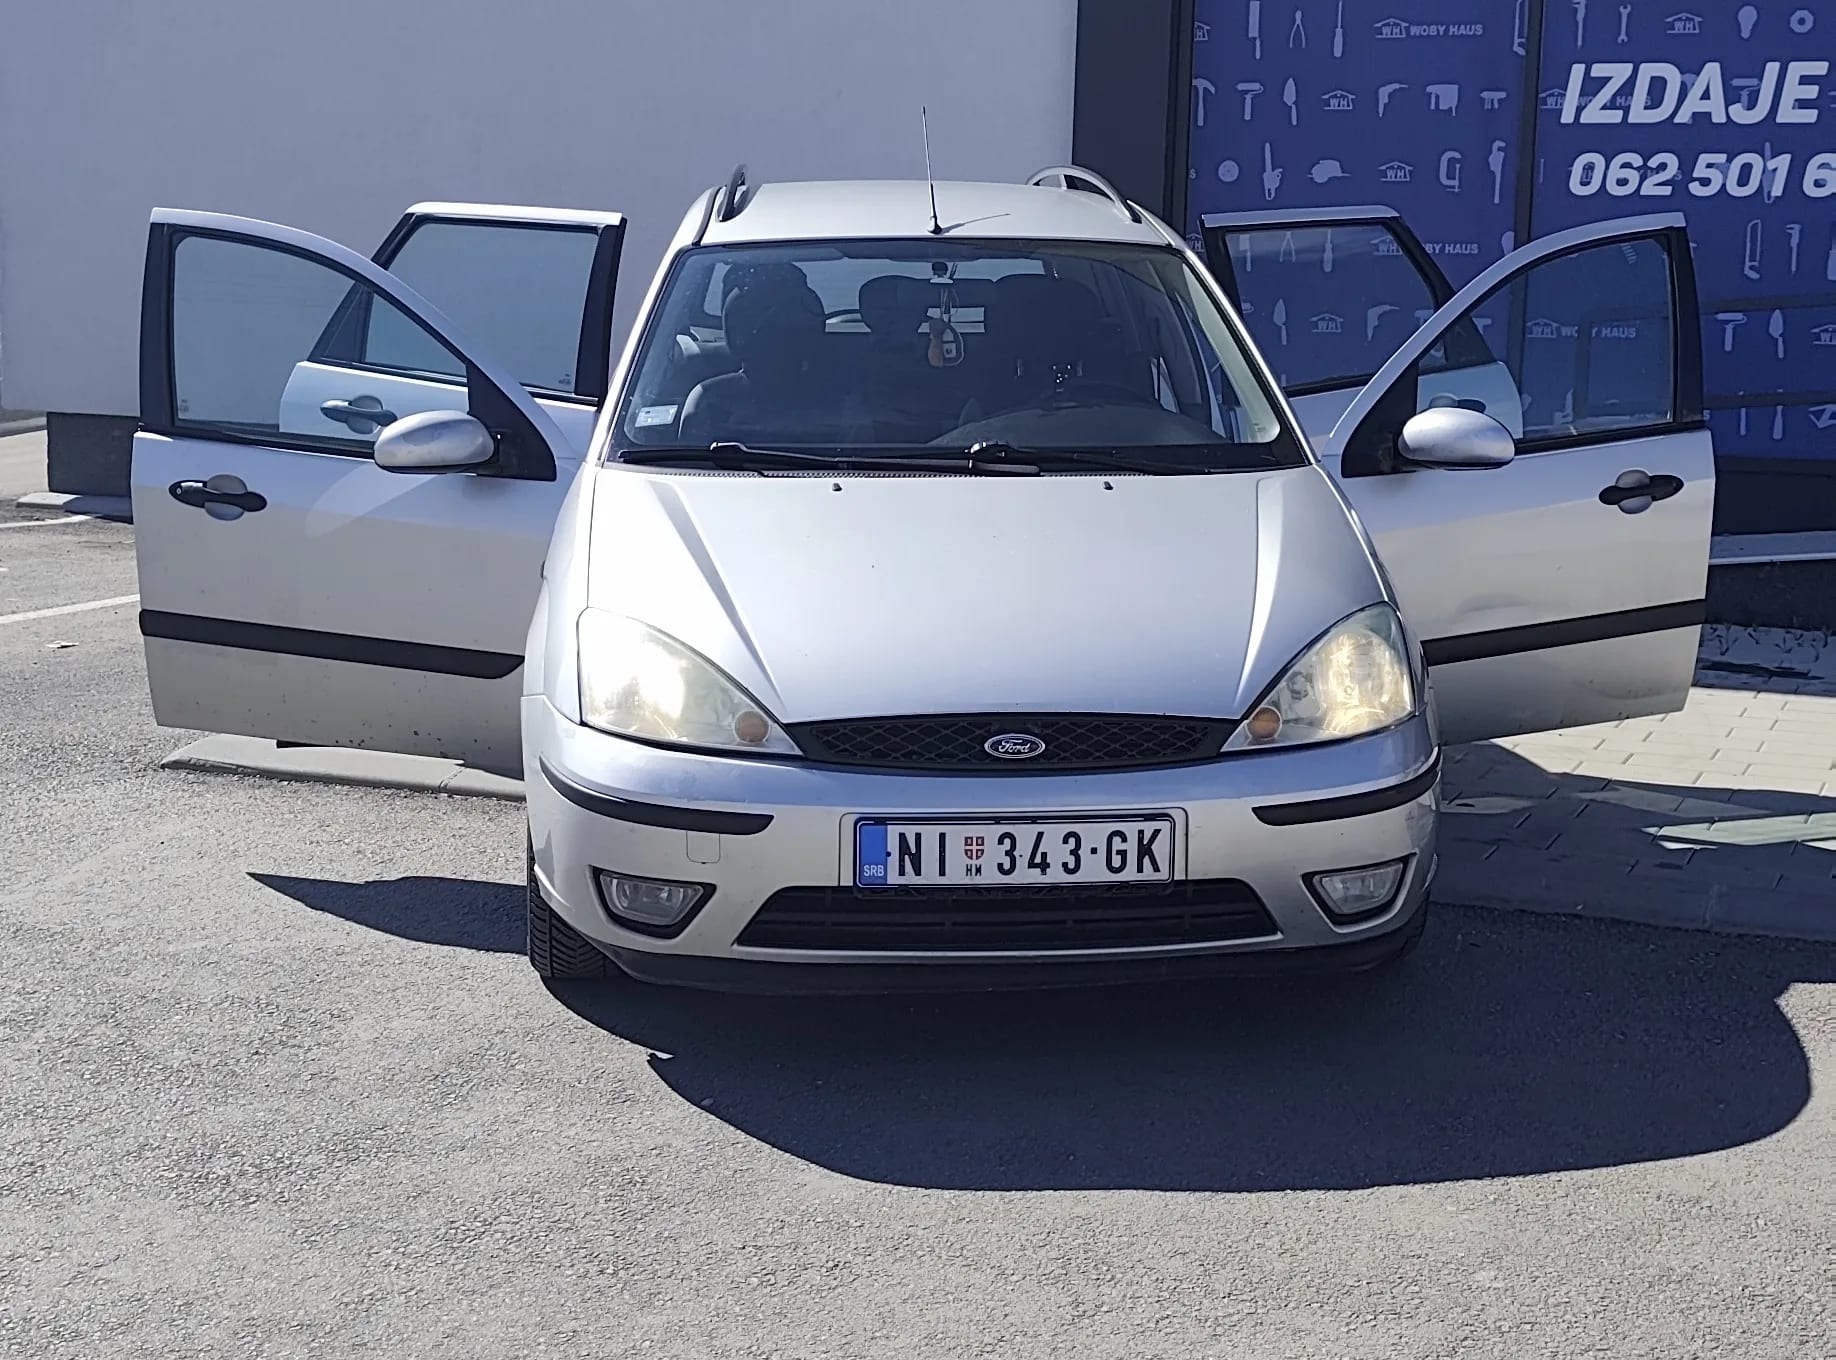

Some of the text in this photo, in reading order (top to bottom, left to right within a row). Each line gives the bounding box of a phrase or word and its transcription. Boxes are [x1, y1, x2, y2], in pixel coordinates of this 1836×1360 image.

[1410, 25, 1445, 36] WOBY
[1450, 24, 1483, 35] HAUS
[1674, 21, 1693, 32] WH
[1560, 61, 1830, 124] IZDAJE
[1329, 98, 1348, 108] WH
[1386, 170, 1405, 180] WH
[1568, 153, 1679, 196] 062
[1688, 153, 1792, 197] 501
[1445, 243, 1479, 254] HAUS
[1601, 327, 1637, 338] HAUS
[999, 739, 1031, 753] Ford
[898, 832, 946, 876] NI
[863, 864, 884, 877] SRB
